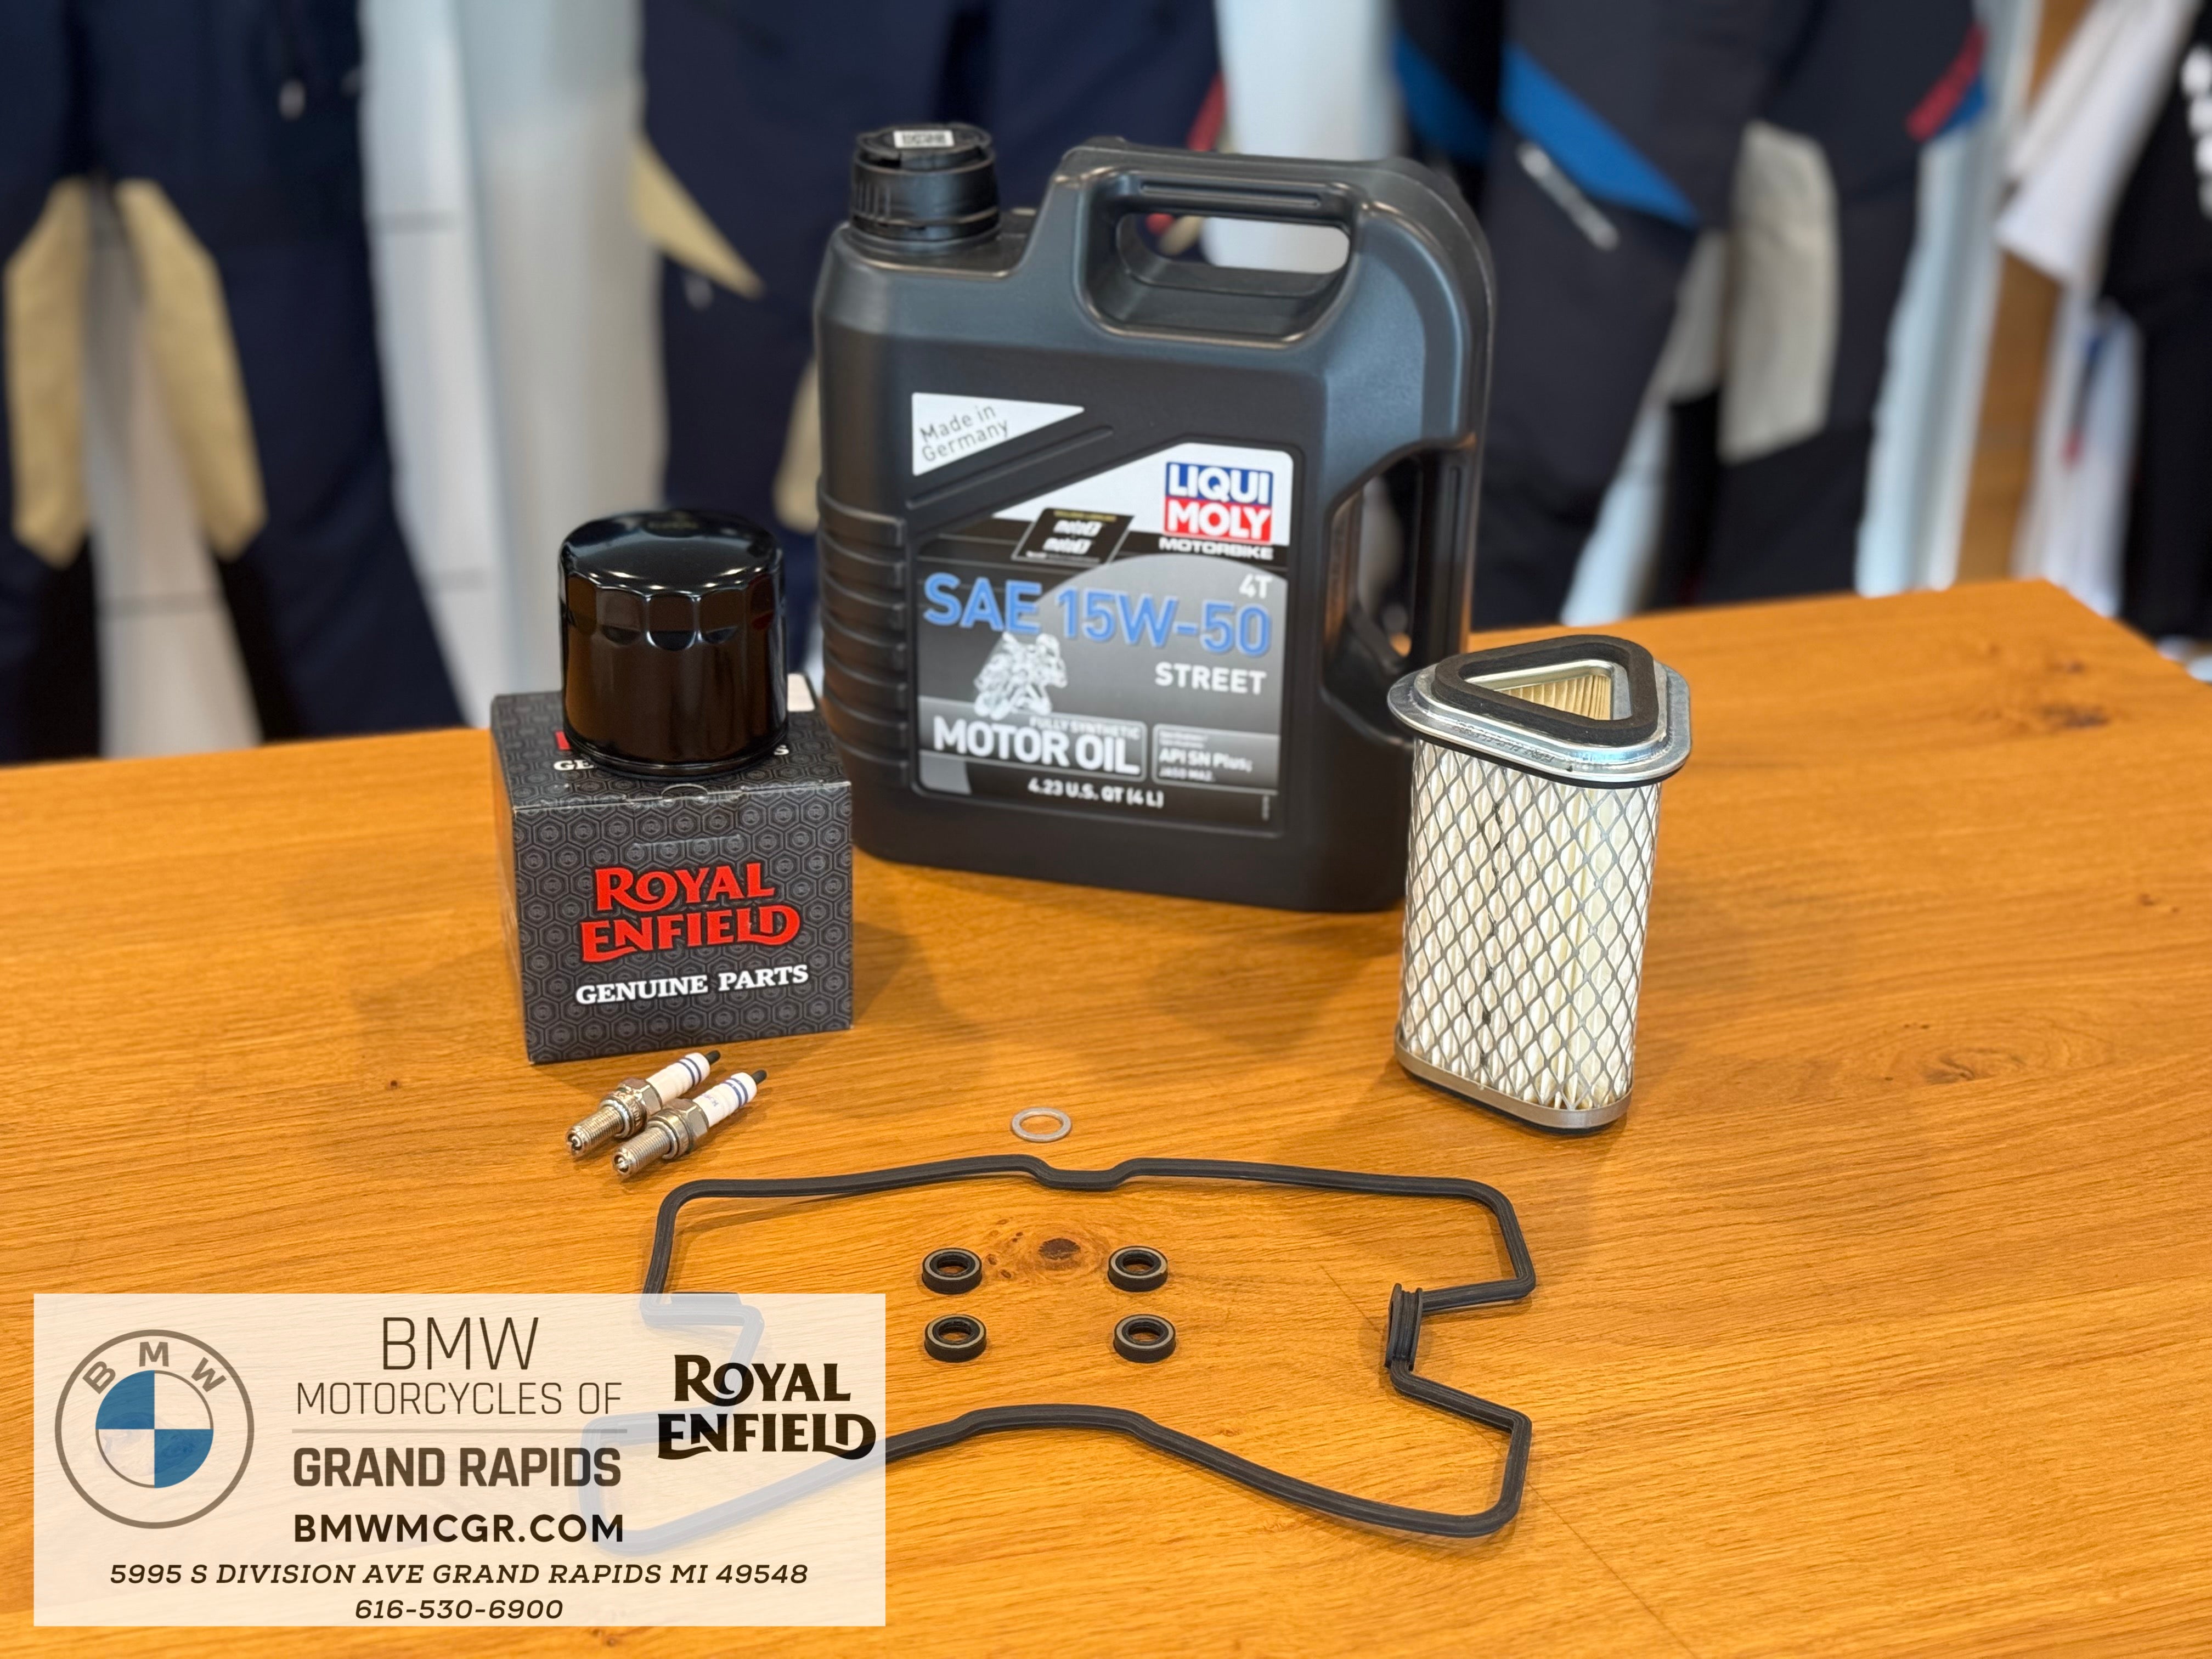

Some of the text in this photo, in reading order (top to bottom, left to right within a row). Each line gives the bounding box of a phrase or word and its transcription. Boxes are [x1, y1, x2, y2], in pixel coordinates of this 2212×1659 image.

[919, 405, 996, 443] Made in
[922, 419, 1008, 462] Germany
[1168, 463, 1270, 504] LIQUI
[1167, 500, 1271, 540] MOLY
[1158, 537, 1274, 561] MOTORBIKE
[1238, 573, 1273, 599] 4T
[923, 572, 1272, 657] SAE 15W-50
[1155, 662, 1267, 695] STREET
[933, 715, 1141, 775] MOTOR OIL
[1028, 776, 1064, 797] 4.23
[1065, 781, 1099, 800] U.S.
[1101, 785, 1124, 803] QT
[595, 862, 775, 912] ROYAL
[580, 904, 801, 962] ENFIELD
[575, 963, 809, 1005] GENUINE PARTS
